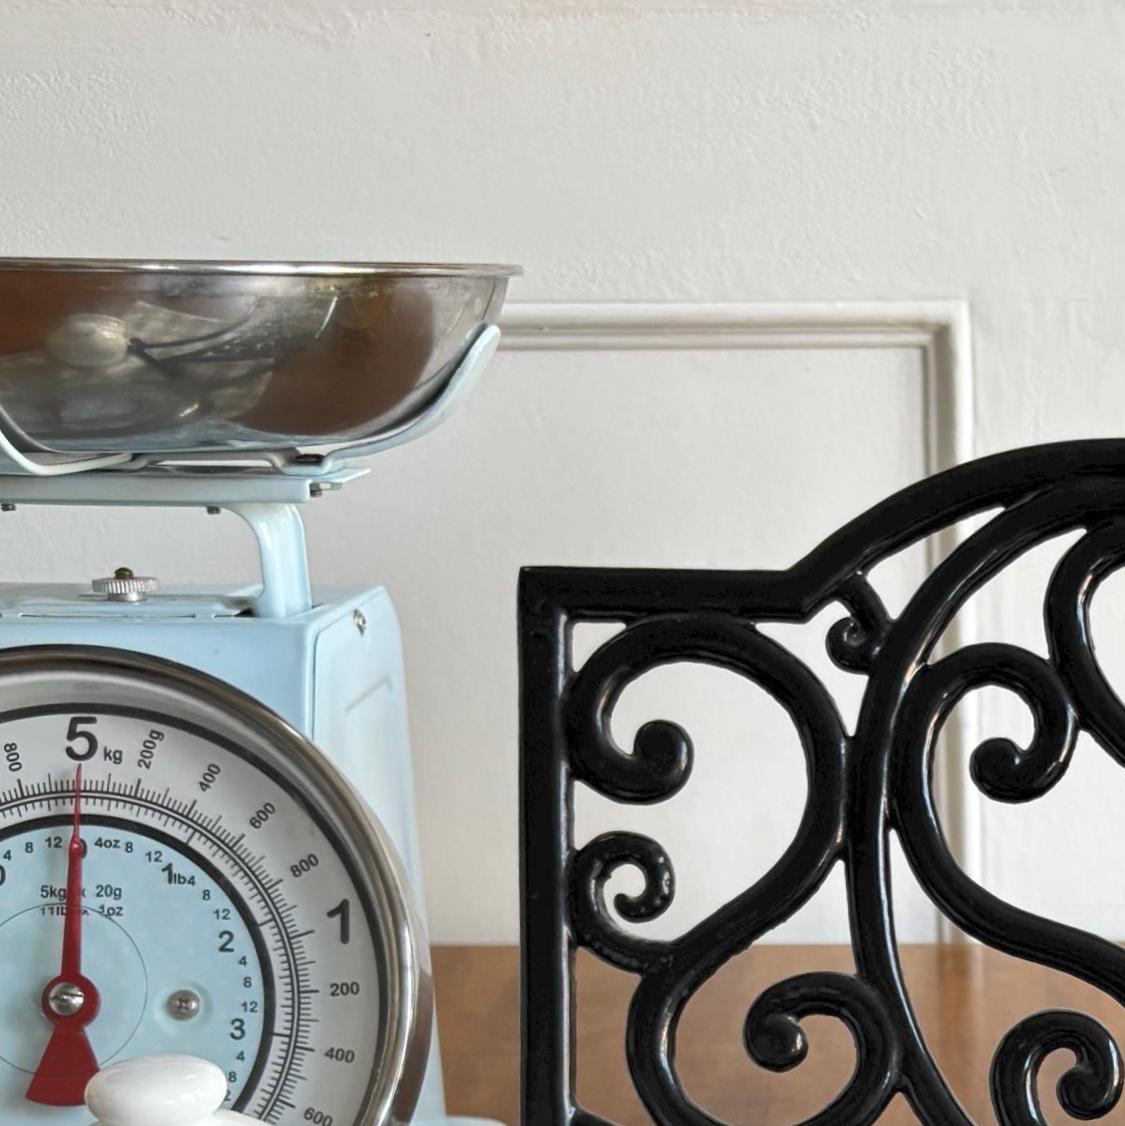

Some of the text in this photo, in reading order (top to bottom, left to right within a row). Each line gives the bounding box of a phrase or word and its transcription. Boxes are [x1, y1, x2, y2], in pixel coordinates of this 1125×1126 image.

[65, 716, 123, 765] 5 kg
[138, 729, 164, 770] 200g
[4, 742, 22, 772] 800
[198, 763, 221, 792] 400
[249, 802, 276, 829] 600
[25, 841, 34, 853] 8
[45, 836, 62, 848] 12
[94, 837, 121, 849] 4oz
[125, 841, 133, 853] 8
[3, 849, 12, 861] 4
[145, 850, 163, 863] 12
[290, 853, 319, 878] 800
[95, 884, 122, 901] 20g
[202, 889, 211, 901] 8
[213, 909, 231, 920] 12
[326, 898, 350, 945] 1
[218, 930, 234, 952] 2
[238, 956, 247, 967] 4
[243, 976, 252, 988] 8
[329, 982, 360, 996] 200
[241, 1001, 258, 1013] 12
[230, 1017, 246, 1041] 3
[236, 1051, 245, 1062] 4
[324, 1047, 355, 1063] 400
[228, 1071, 237, 1083] 8
